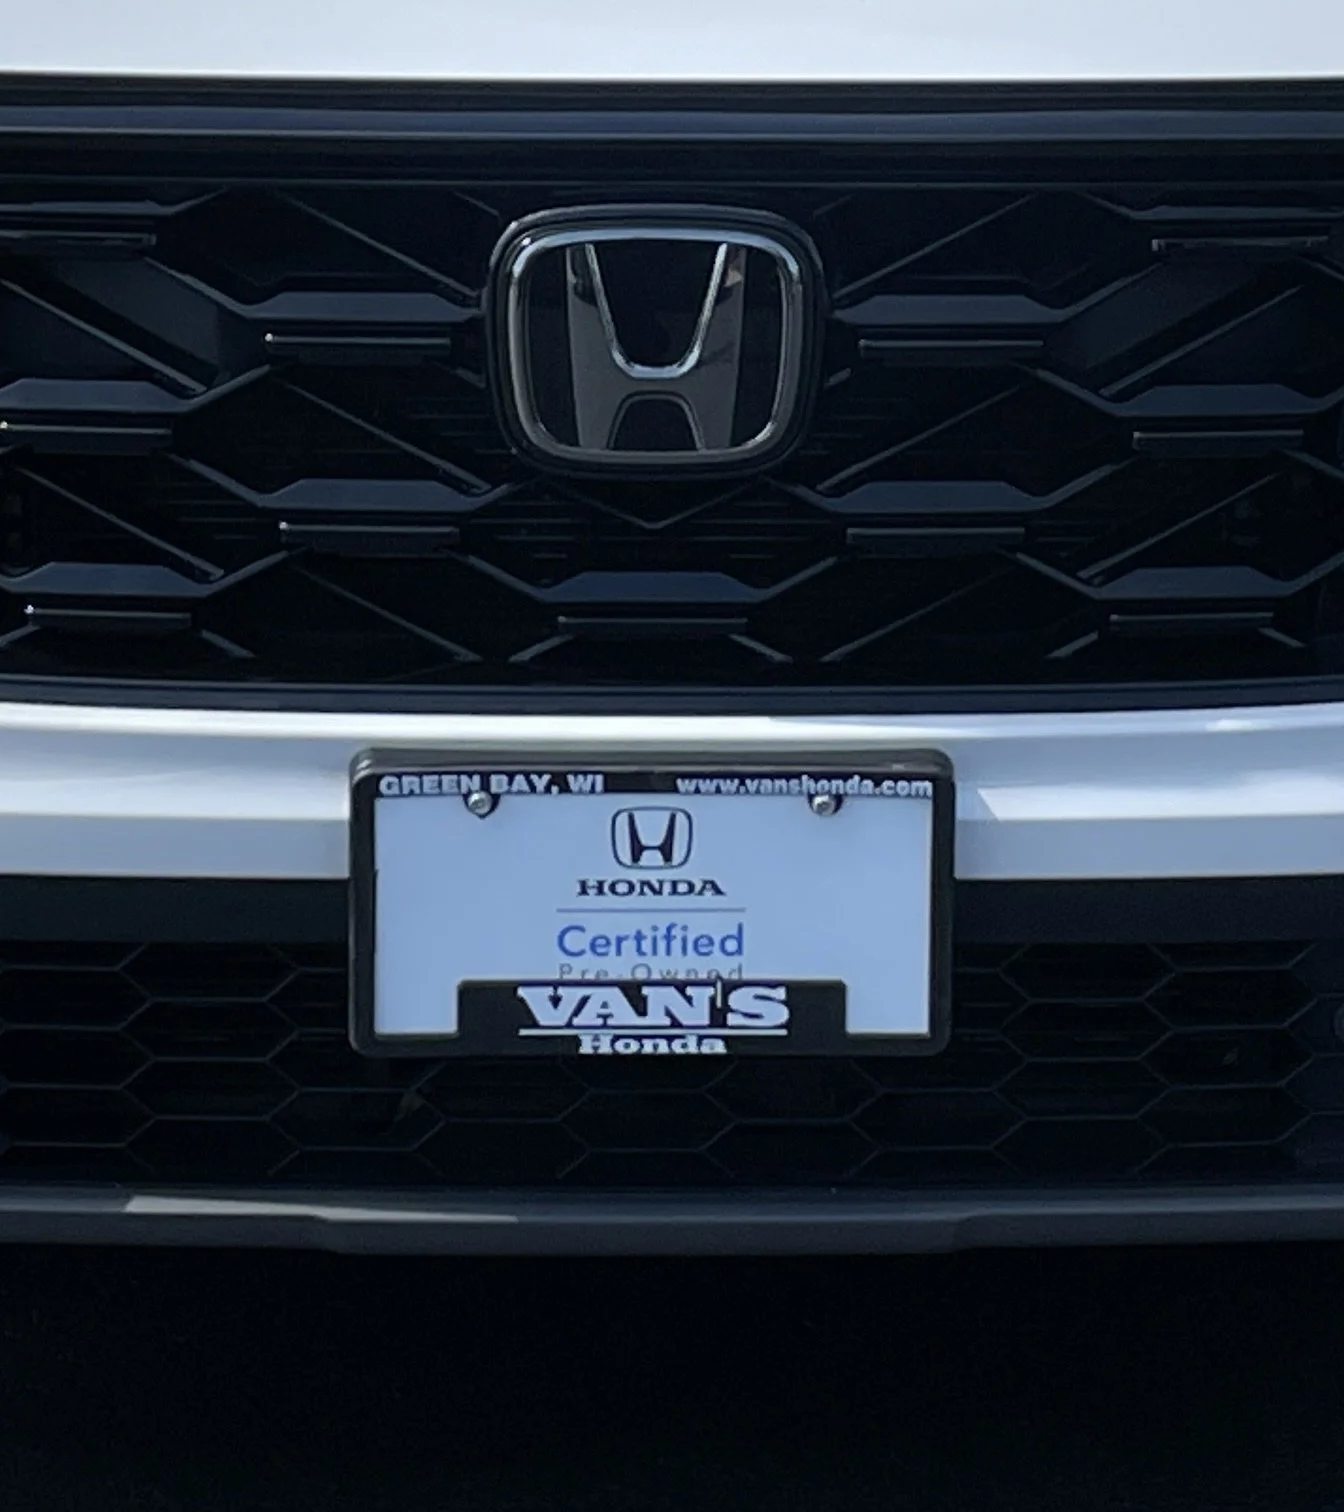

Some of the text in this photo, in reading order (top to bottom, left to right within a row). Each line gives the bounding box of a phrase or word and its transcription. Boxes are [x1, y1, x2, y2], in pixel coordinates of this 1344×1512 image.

[379, 773, 605, 795] GREEN BAY, WI
[676, 774, 933, 796] www.vanshonda.com
[577, 879, 727, 897] HONDA
[557, 922, 744, 957] Certified
[516, 979, 790, 1027] VAN'S
[577, 1033, 728, 1055] Honda
